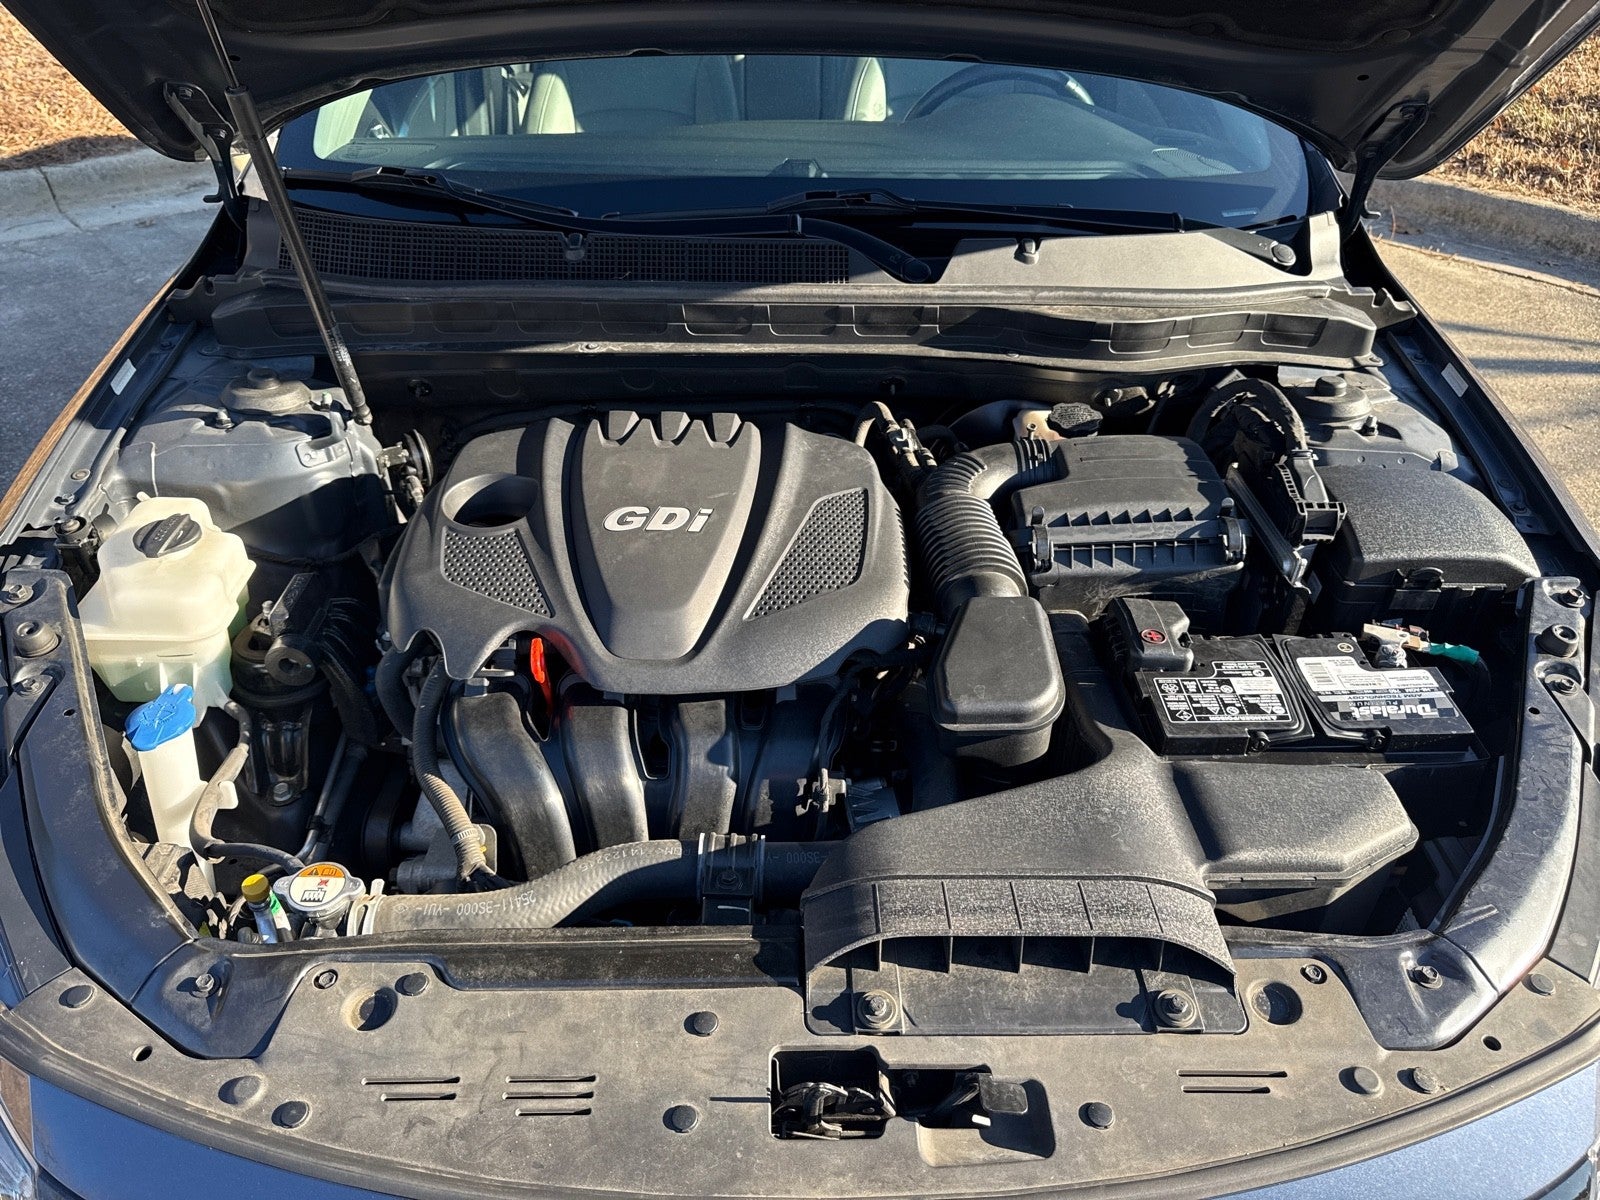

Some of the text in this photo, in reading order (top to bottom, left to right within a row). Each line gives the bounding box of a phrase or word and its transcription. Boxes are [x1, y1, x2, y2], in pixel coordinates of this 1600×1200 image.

[603, 506, 714, 532] GDi
[1350, 703, 1438, 719] Duralast
[456, 890, 537, 916] 25411-3S000
